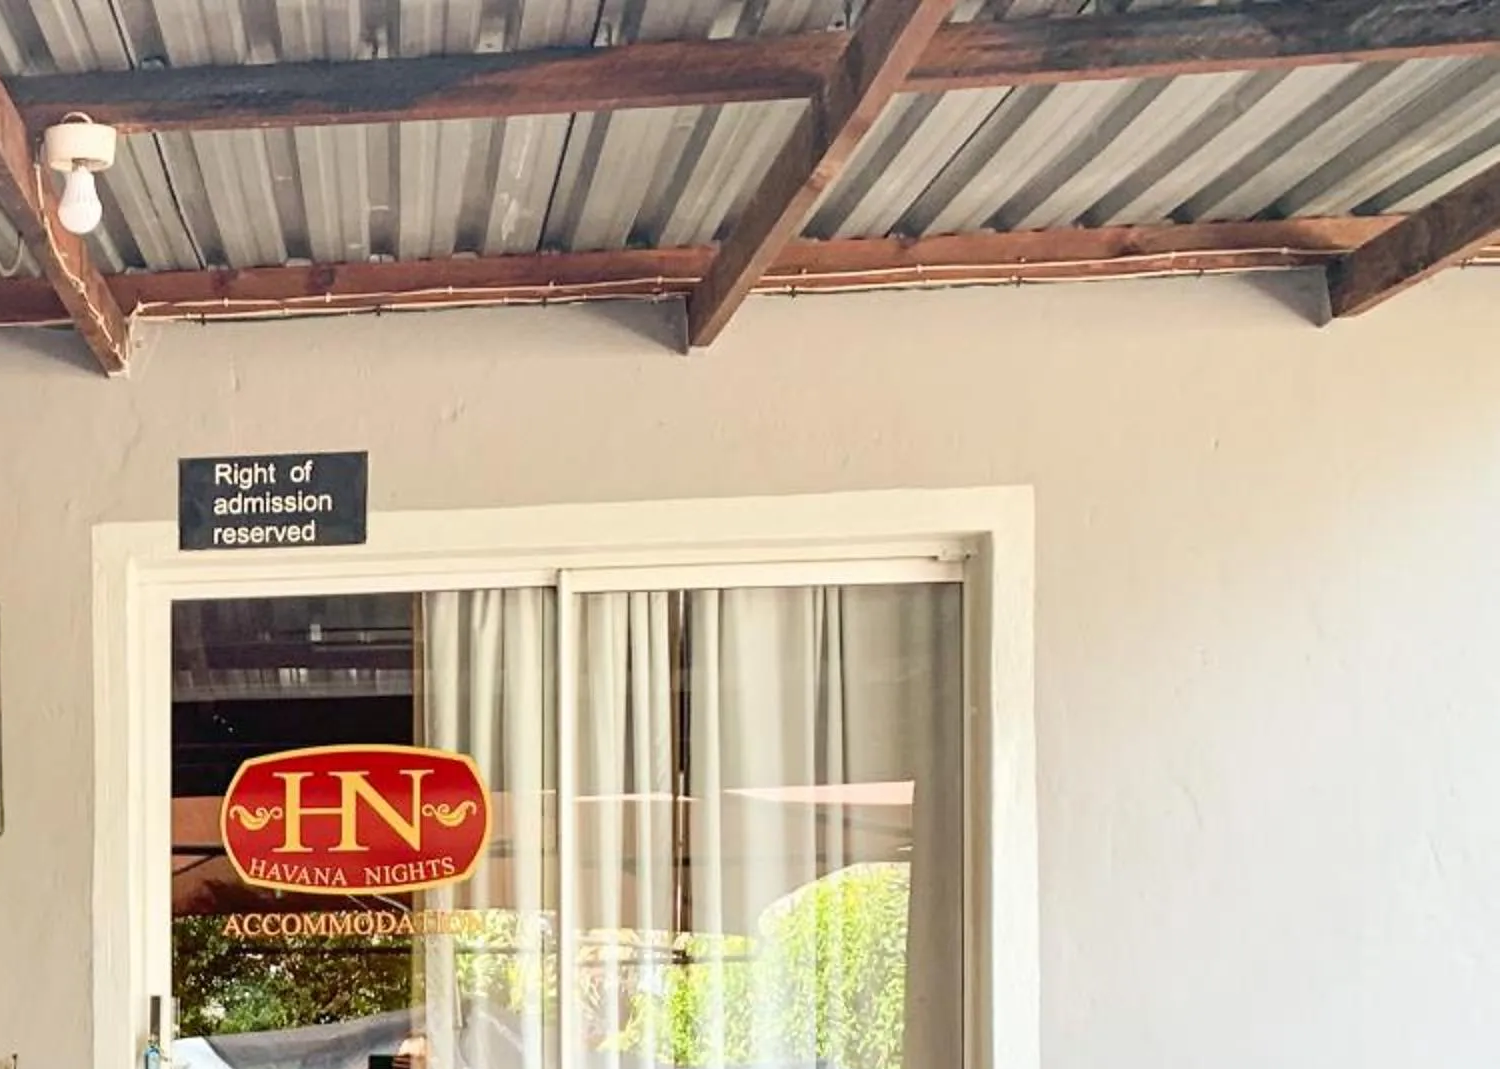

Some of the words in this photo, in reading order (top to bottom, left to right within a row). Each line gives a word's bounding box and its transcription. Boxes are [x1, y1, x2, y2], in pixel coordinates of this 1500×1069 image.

[215, 463, 276, 489] Right
[290, 460, 313, 483] of
[213, 491, 332, 515] admission
[213, 520, 315, 544] reserved
[272, 769, 435, 852] HN
[250, 858, 347, 886] HAVANA
[364, 857, 455, 884] NIGHTS
[222, 911, 483, 937] ACCOMMODATI
